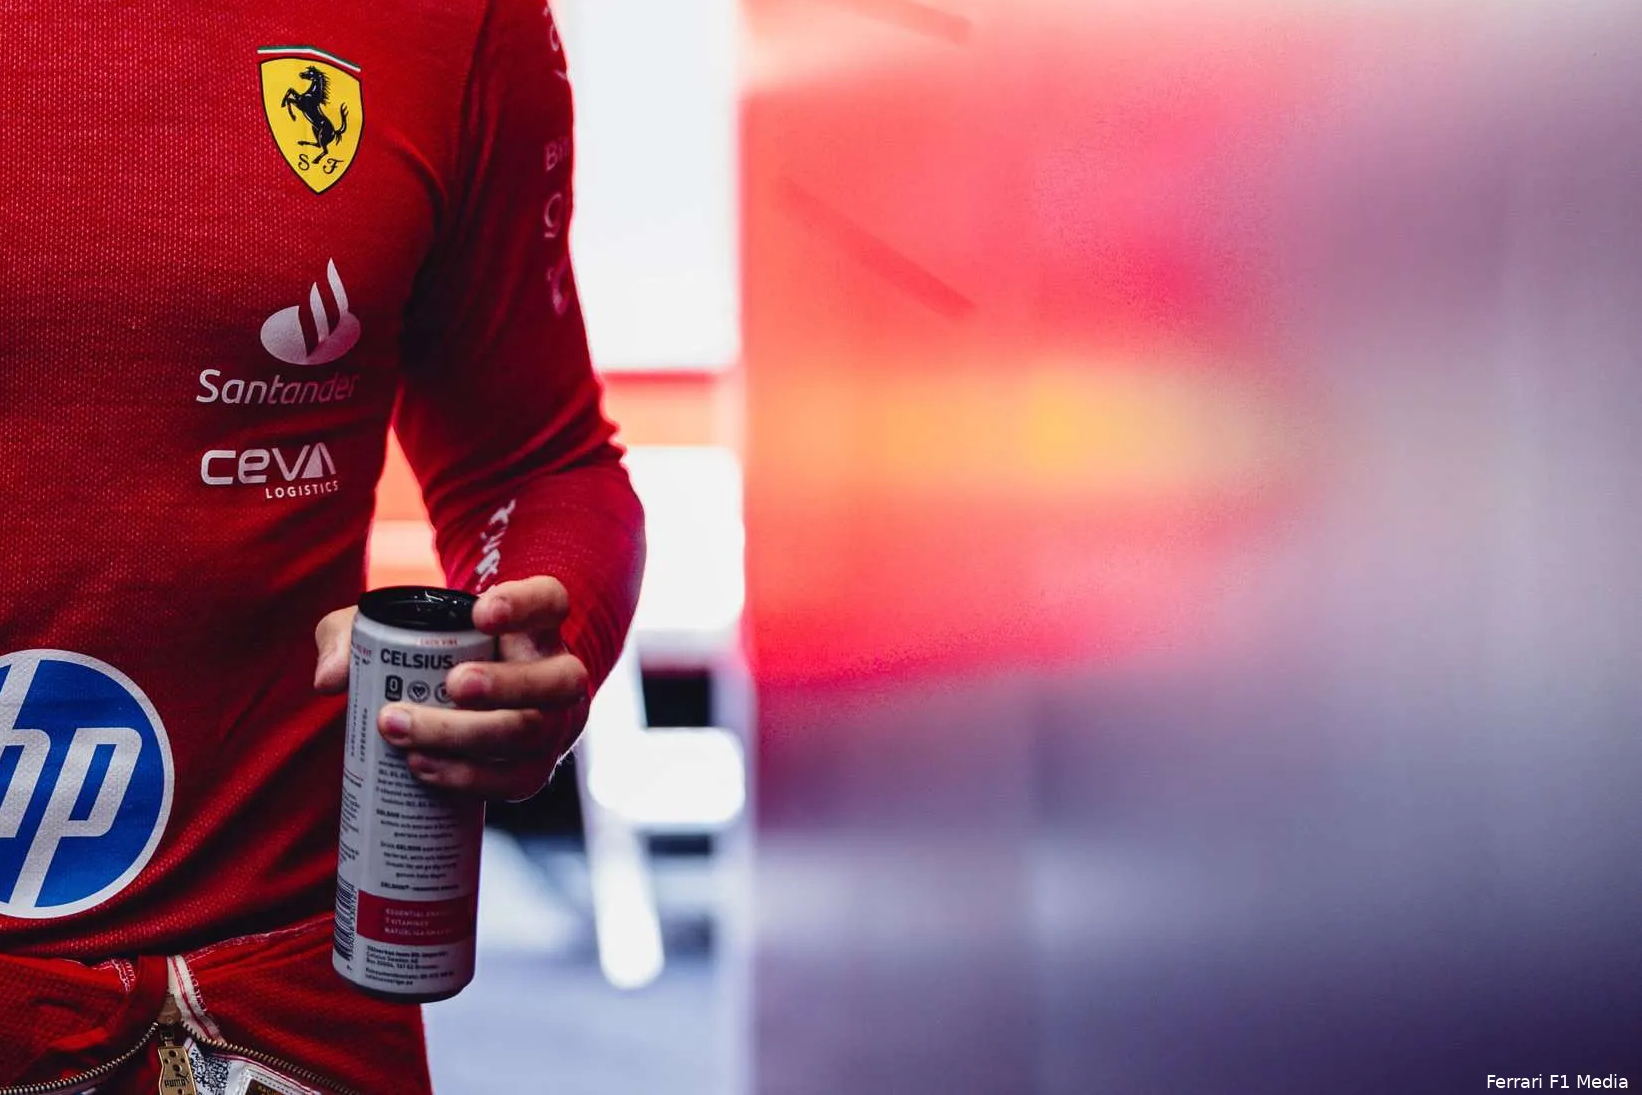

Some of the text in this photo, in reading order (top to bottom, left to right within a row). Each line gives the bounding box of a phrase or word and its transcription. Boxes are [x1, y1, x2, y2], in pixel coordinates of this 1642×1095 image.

[196, 368, 360, 405] Santander
[265, 480, 339, 499] LOGISTICS
[380, 648, 454, 670] CELSIUS
